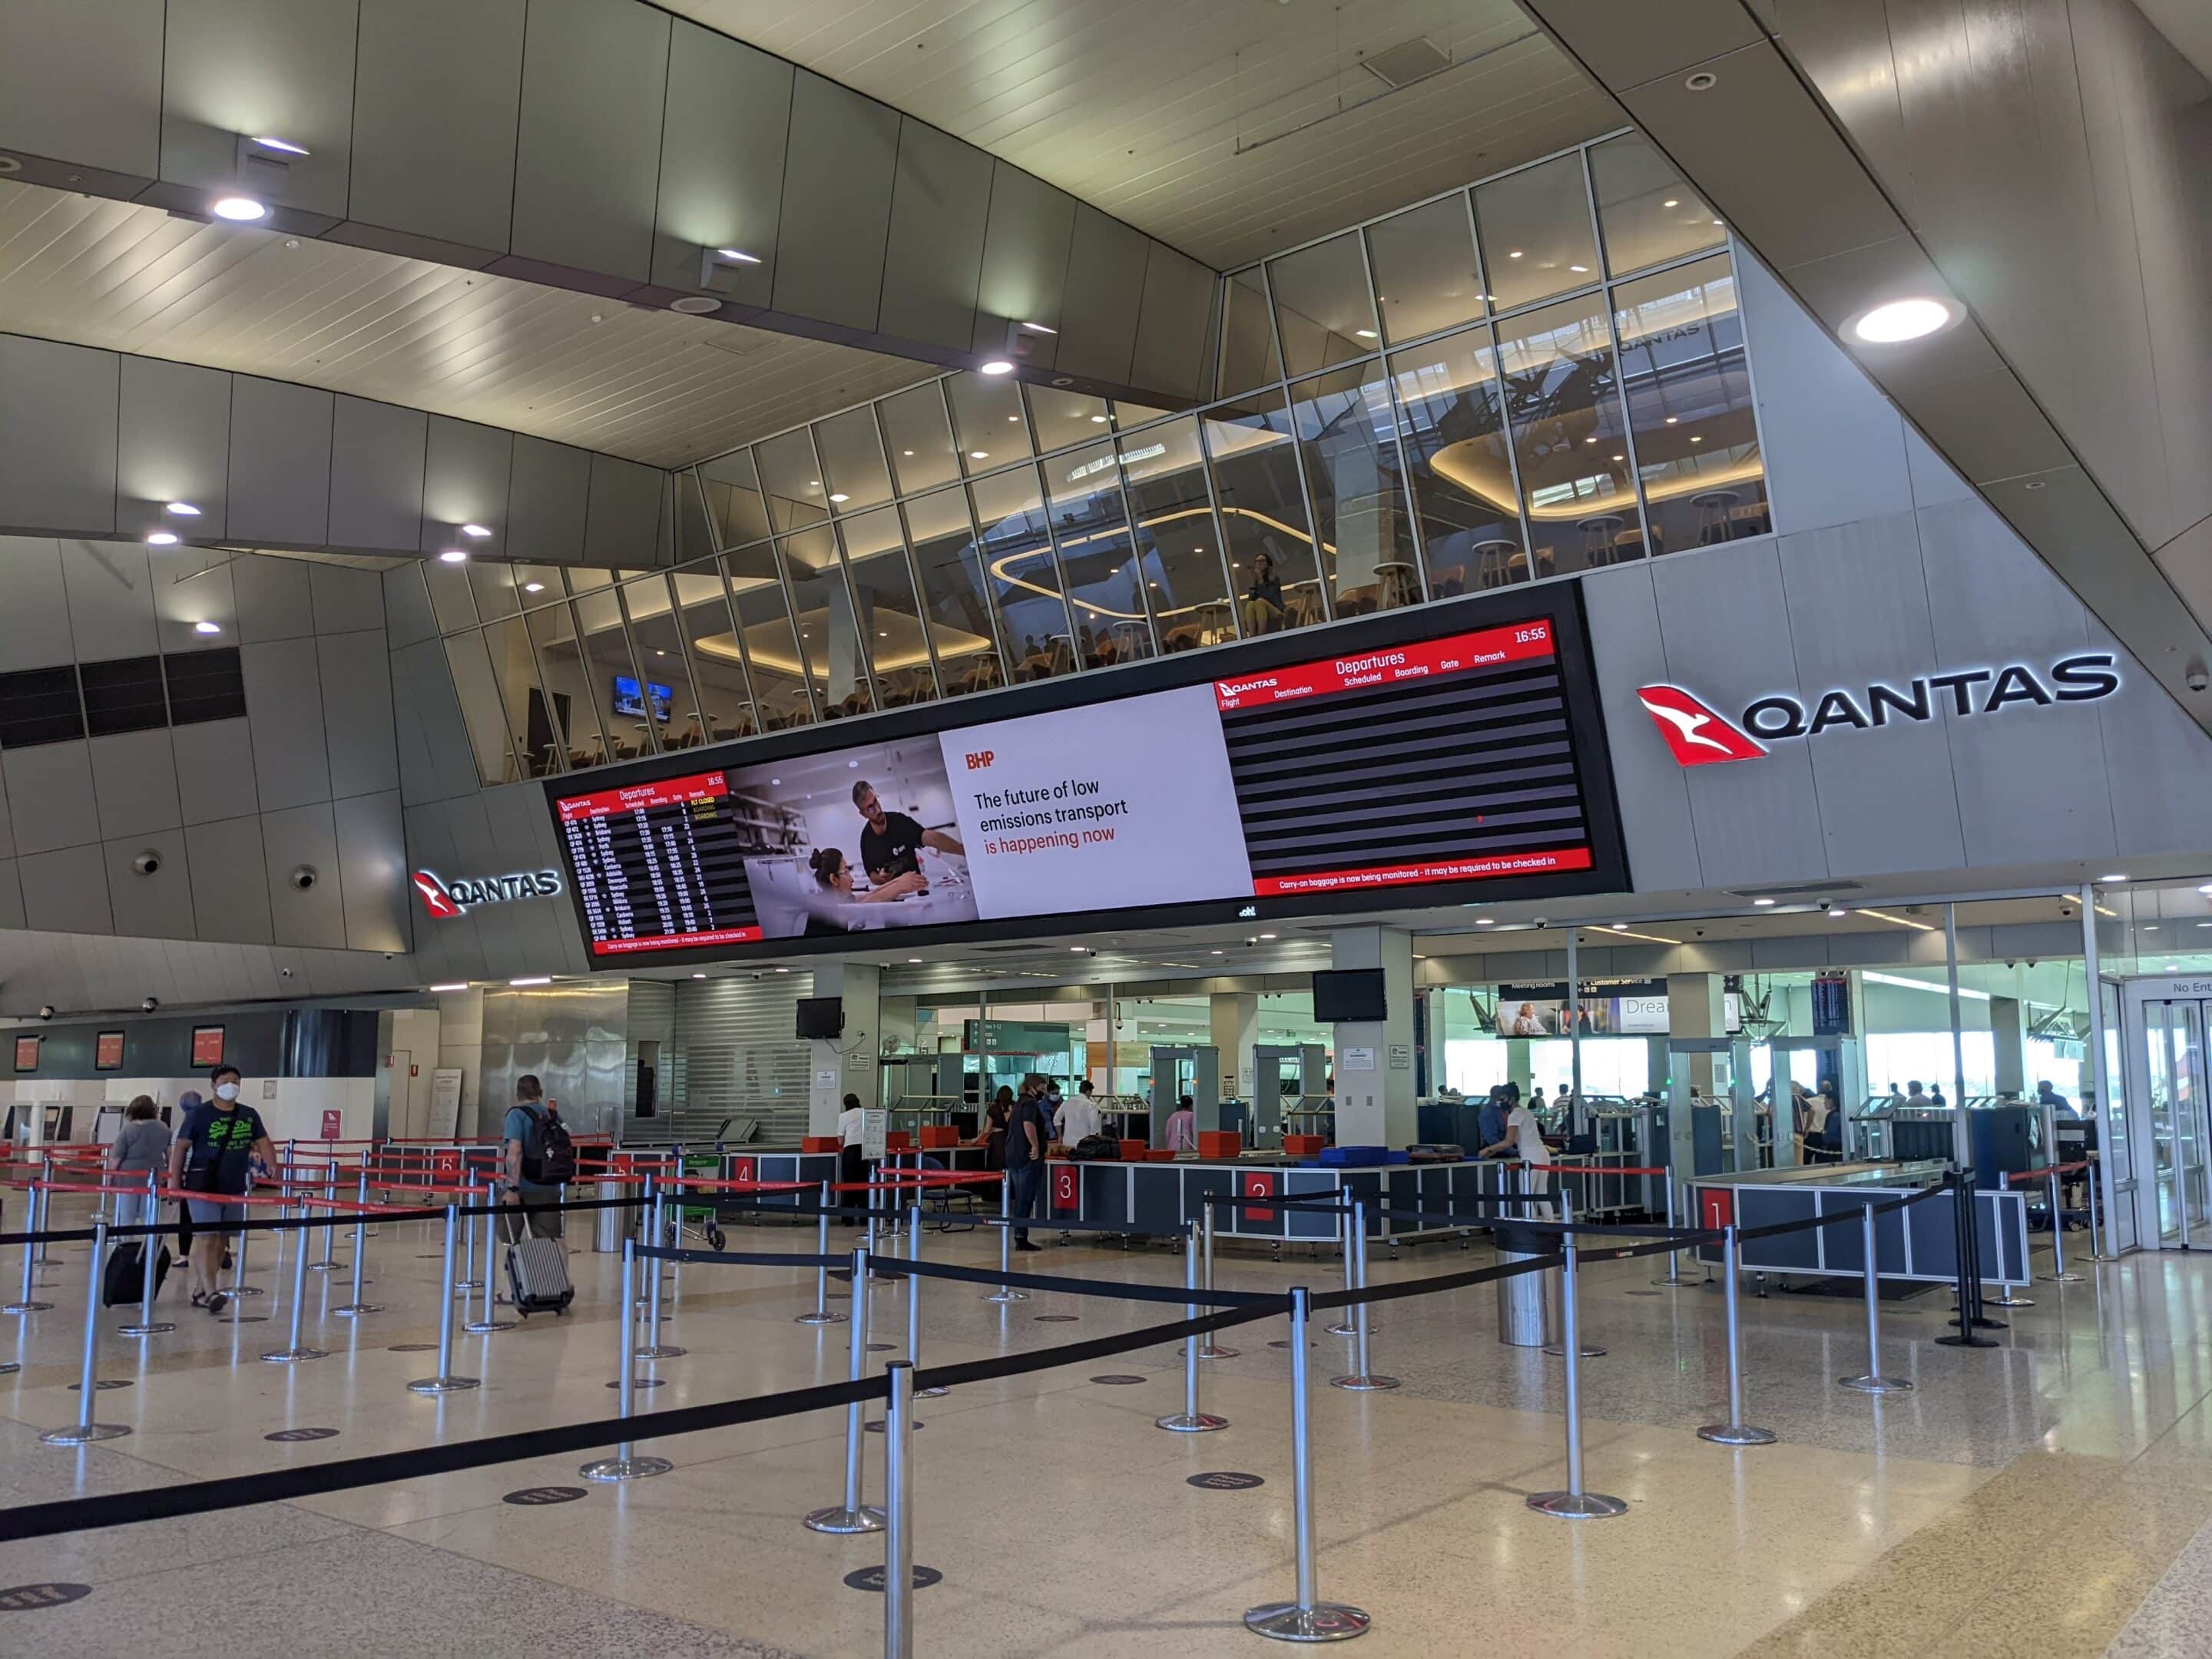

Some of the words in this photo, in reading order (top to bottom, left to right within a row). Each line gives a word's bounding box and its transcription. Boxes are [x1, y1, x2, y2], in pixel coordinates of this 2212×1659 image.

[1515, 627, 1546, 644] 16:55
[1336, 653, 1406, 675] Departures
[1221, 698, 1240, 708] Flight
[1274, 686, 1313, 699] Destination
[1344, 672, 1382, 687] Scheduled
[1395, 665, 1429, 678] Boarding
[1441, 660, 1459, 670] Gate
[1474, 651, 1506, 664] Remark
[1233, 678, 1278, 693] QANTAS
[1742, 655, 2120, 740] QANTAS
[965, 750, 995, 770] BHP
[707, 776, 724, 786] 16:55
[619, 787, 655, 800] Departures
[698, 796, 714, 805] CLOSED
[973, 793, 1002, 810] The
[1004, 786, 1050, 806] future
[1053, 780, 1068, 798] of
[1071, 780, 1099, 795] low
[980, 811, 1052, 833] emissions
[1055, 800, 1128, 824] transport
[984, 839, 997, 855] is
[998, 831, 1079, 855] happening
[1083, 828, 1115, 843] now
[1280, 878, 1309, 889] Carry-on
[1309, 876, 1338, 888] baggage
[1362, 872, 1382, 883] being
[1382, 869, 1419, 879] monitored
[1432, 866, 1448, 876] may
[1449, 865, 1459, 874] be
[1459, 863, 1491, 875] required
[1513, 858, 1546, 868] checked
[1548, 857, 1556, 866] in
[449, 873, 560, 905] QANTAS
[2174, 984, 2189, 992] No
[1627, 999, 1665, 1014] Drea
[739, 1166, 749, 1181] 4
[1060, 1175, 1071, 1199] 3
[1253, 1183, 1267, 1201] 2
[1711, 1203, 1720, 1230] 1
